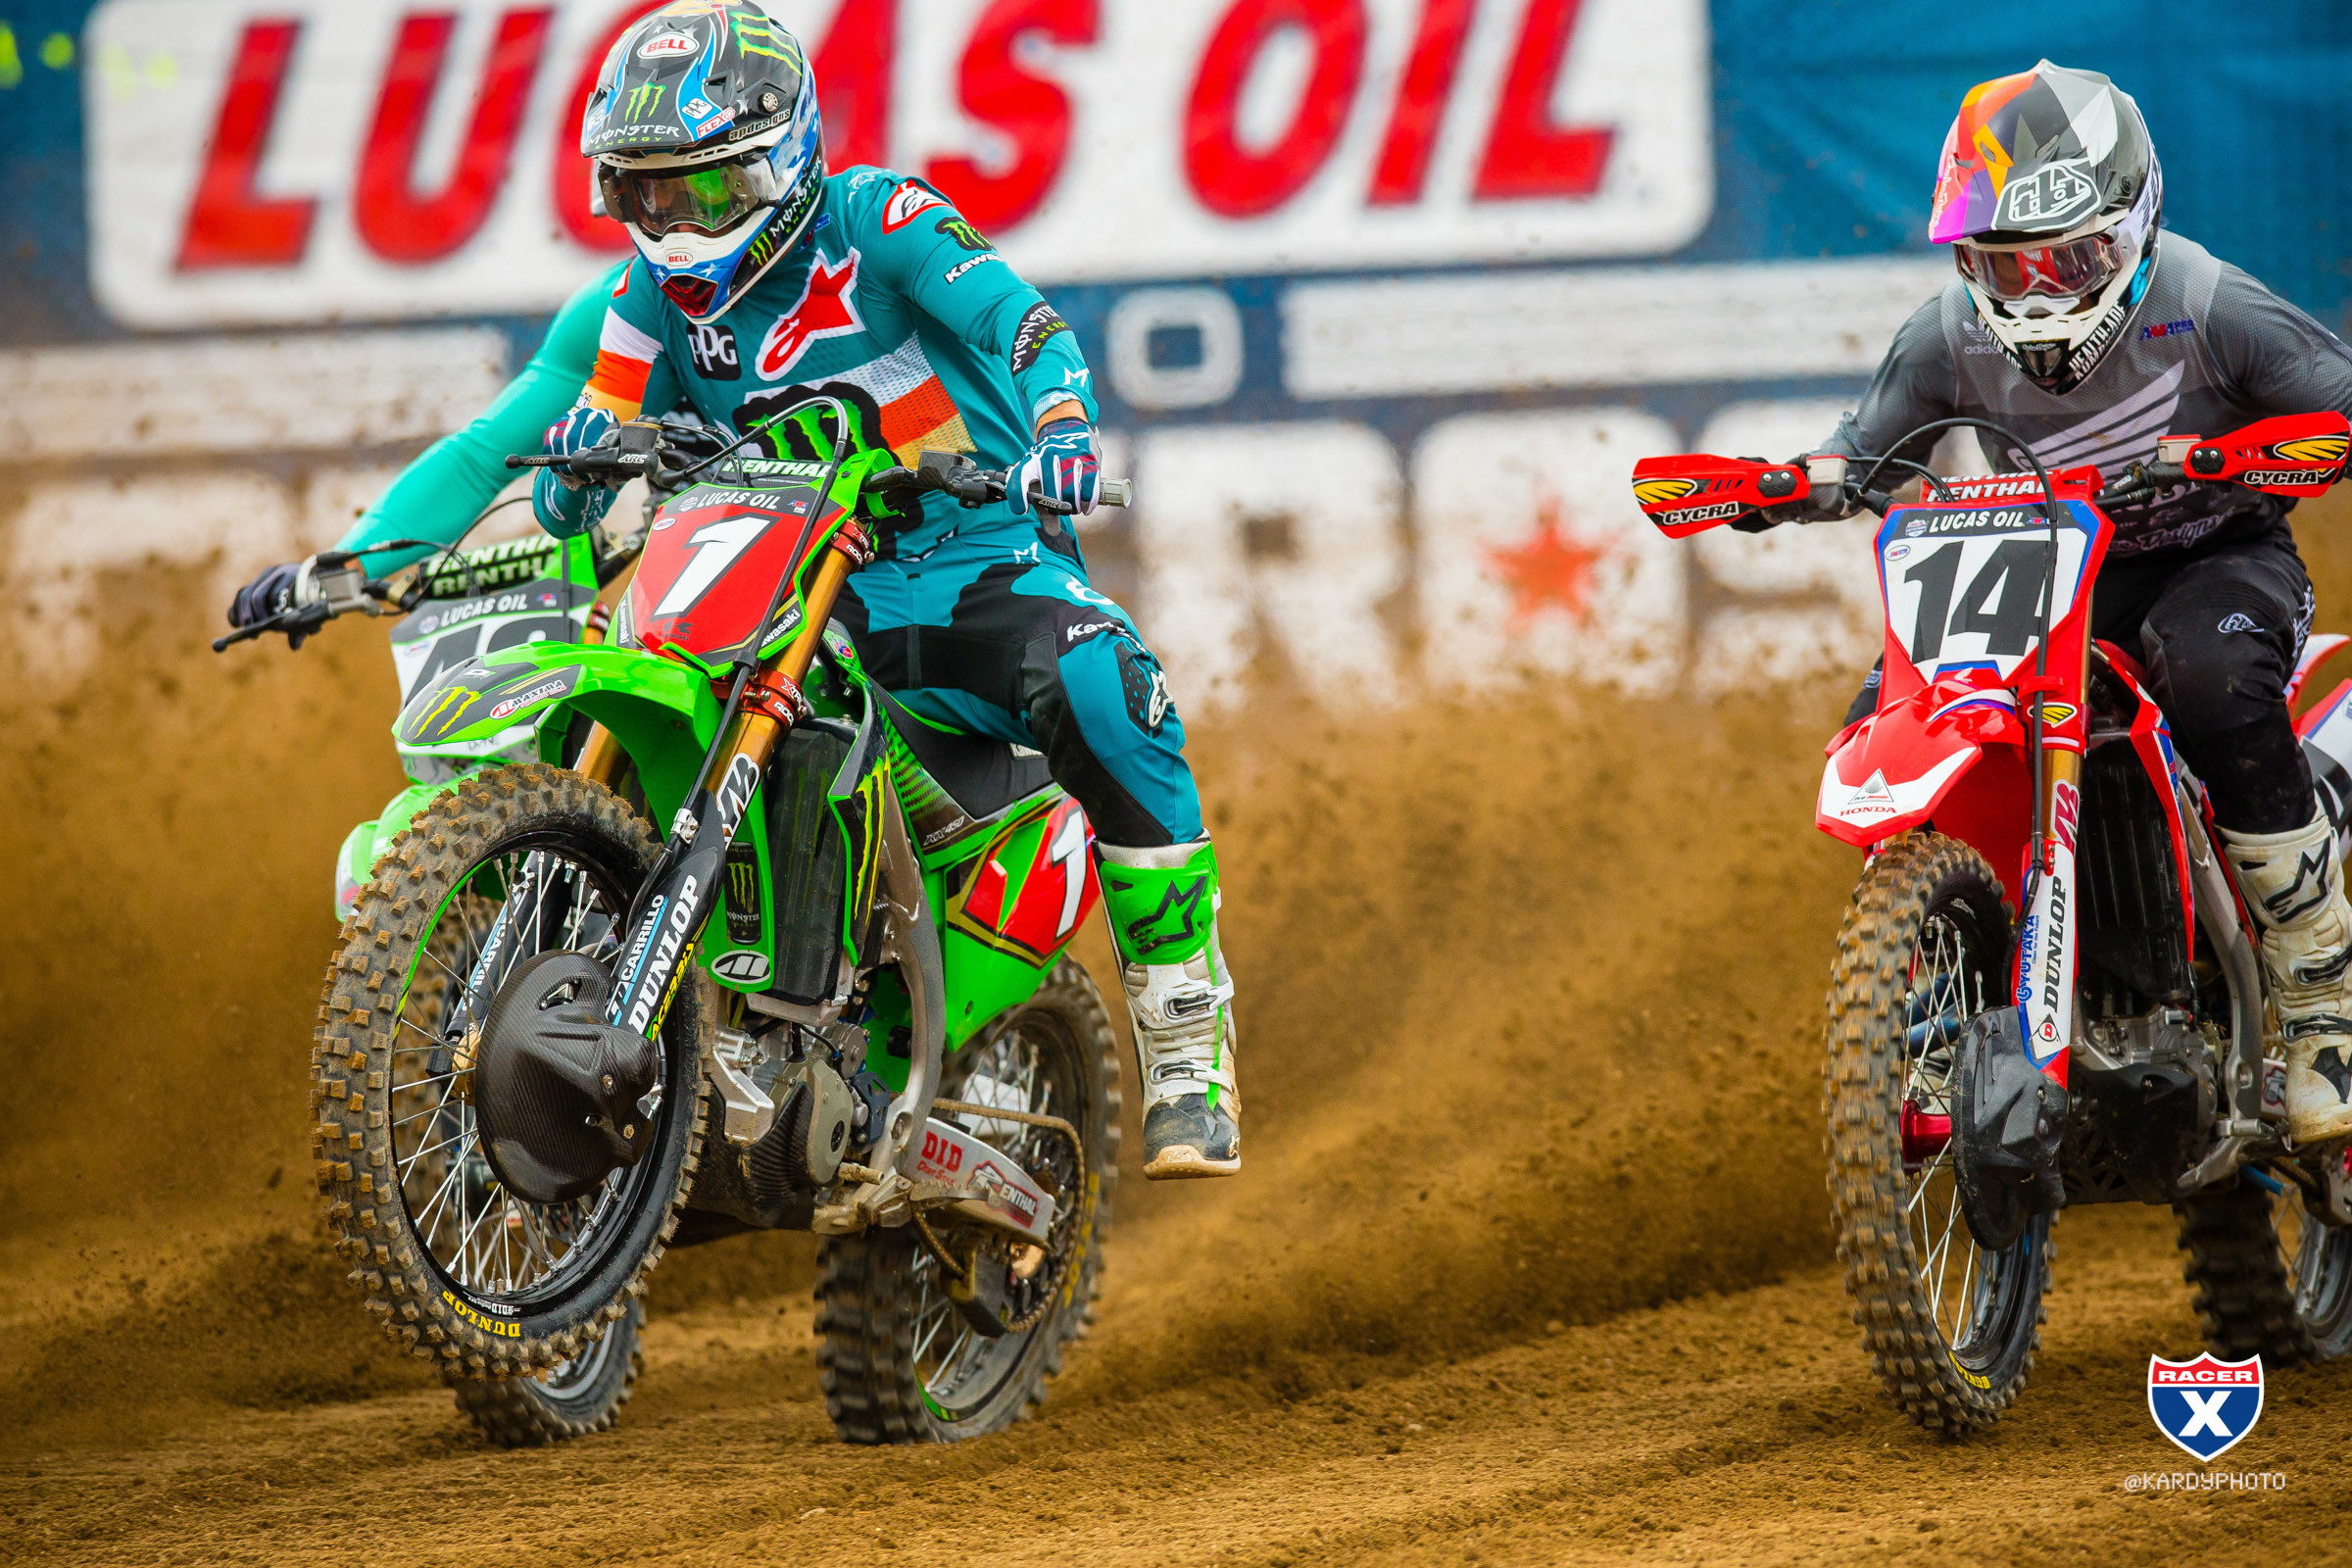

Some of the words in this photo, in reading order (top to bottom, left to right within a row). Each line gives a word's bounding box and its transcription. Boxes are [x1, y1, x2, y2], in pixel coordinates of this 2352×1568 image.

[647, 38, 688, 54] BELL
[729, 109, 791, 141] apdesigns
[1184, 0, 1622, 220] OIL
[668, 254, 690, 263] BELL
[688, 325, 739, 371] PPG
[617, 453, 649, 465] ARC
[2243, 469, 2319, 486] CYCRA
[697, 490, 746, 509] LUCAS
[749, 492, 781, 511] OIL
[1662, 501, 1740, 525] CYCRA
[1929, 511, 1990, 534] LUCAS
[1992, 511, 2025, 528] OIL
[654, 515, 772, 617] 1
[441, 597, 495, 628] LUCAS
[498, 593, 528, 612] OIL
[1904, 539, 2050, 663] 14
[760, 608, 802, 648] wasaki
[1839, 806, 1898, 817] HONDA
[1051, 808, 1088, 939] 1
[621, 893, 665, 980] CARRILLO
[627, 874, 699, 1036] DUNLOP
[2043, 875, 2068, 1014] DUNLOP
[442, 1290, 521, 1338] DUNLOP
